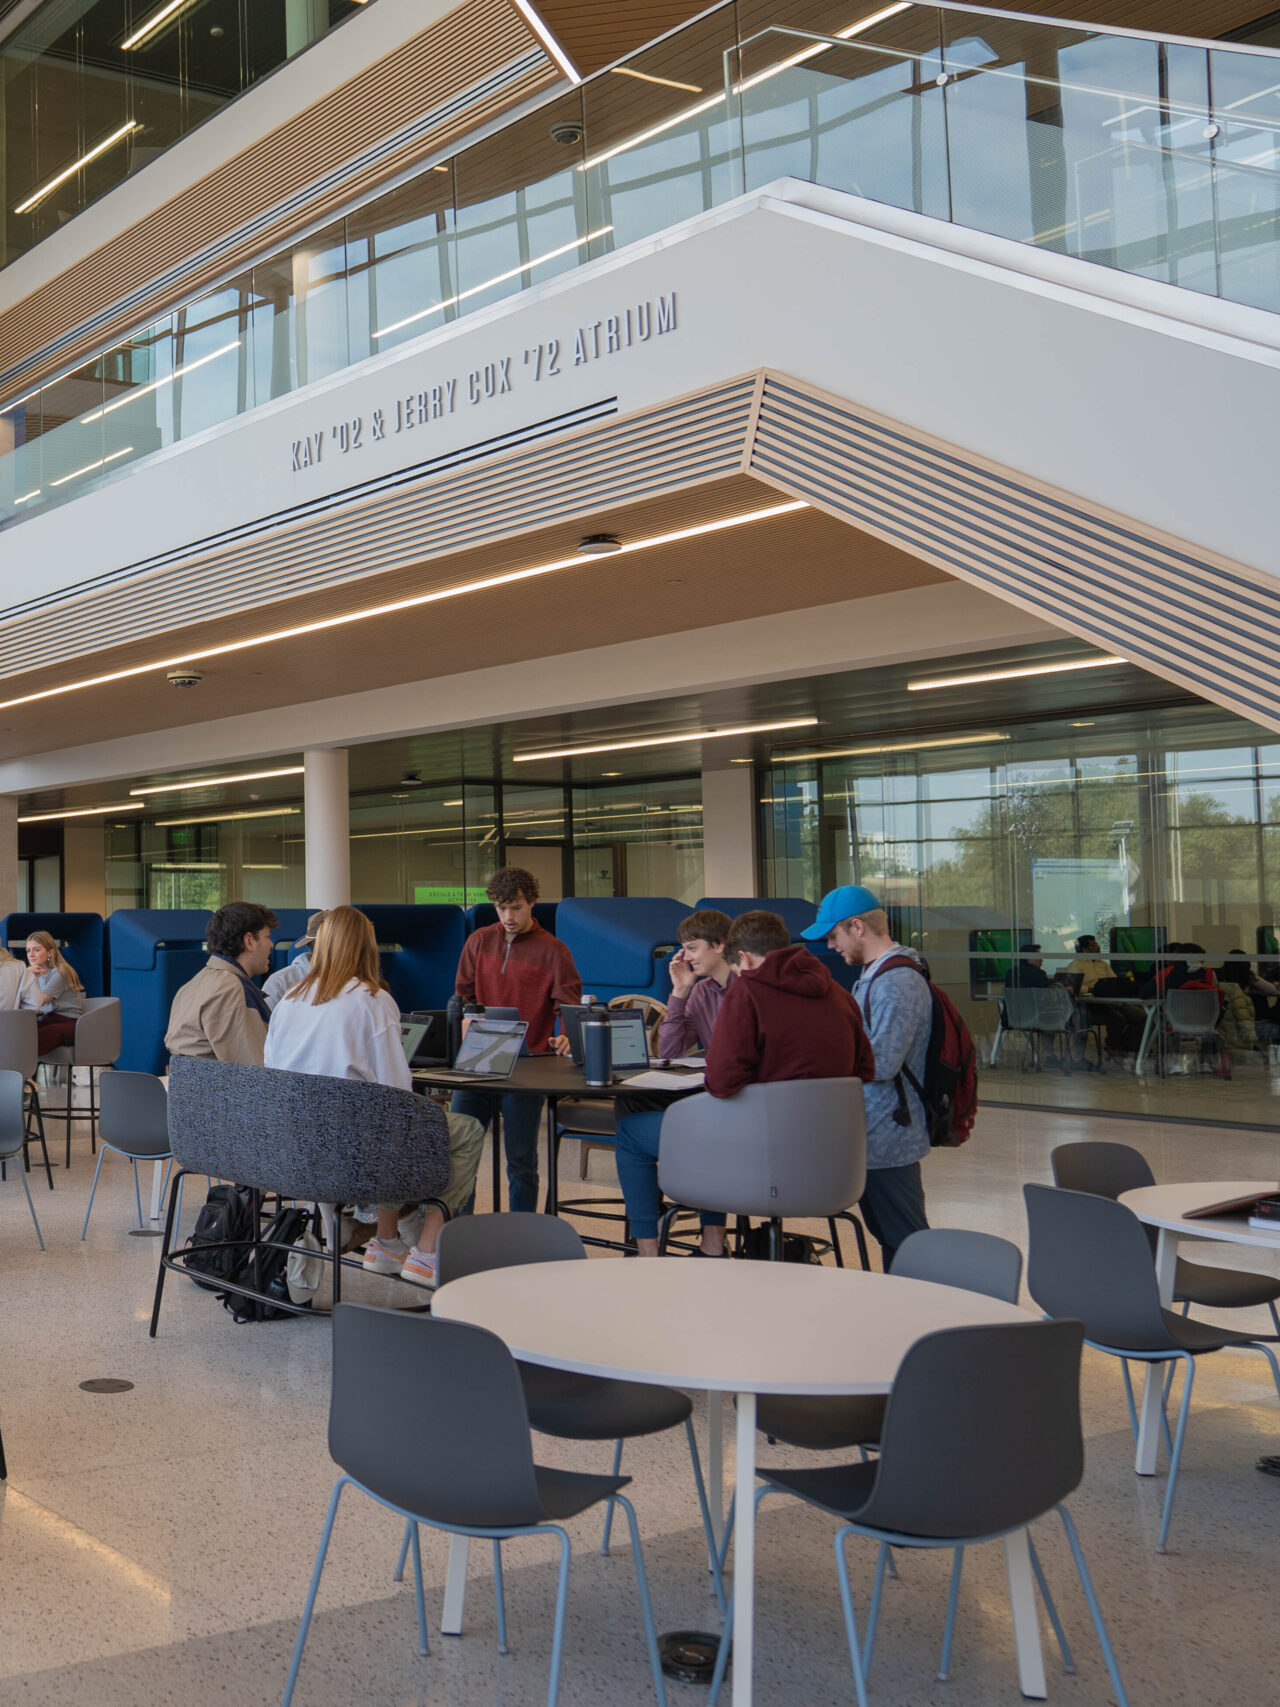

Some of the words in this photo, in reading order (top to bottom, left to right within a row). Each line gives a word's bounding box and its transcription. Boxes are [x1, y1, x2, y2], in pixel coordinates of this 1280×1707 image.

[291, 430, 324, 471] KAY
[332, 416, 363, 454] '02
[371, 409, 385, 441] &
[394, 378, 458, 434] JERRY
[468, 356, 512, 406] COX
[523, 338, 561, 381] '72
[574, 291, 678, 367] ATRIUM
